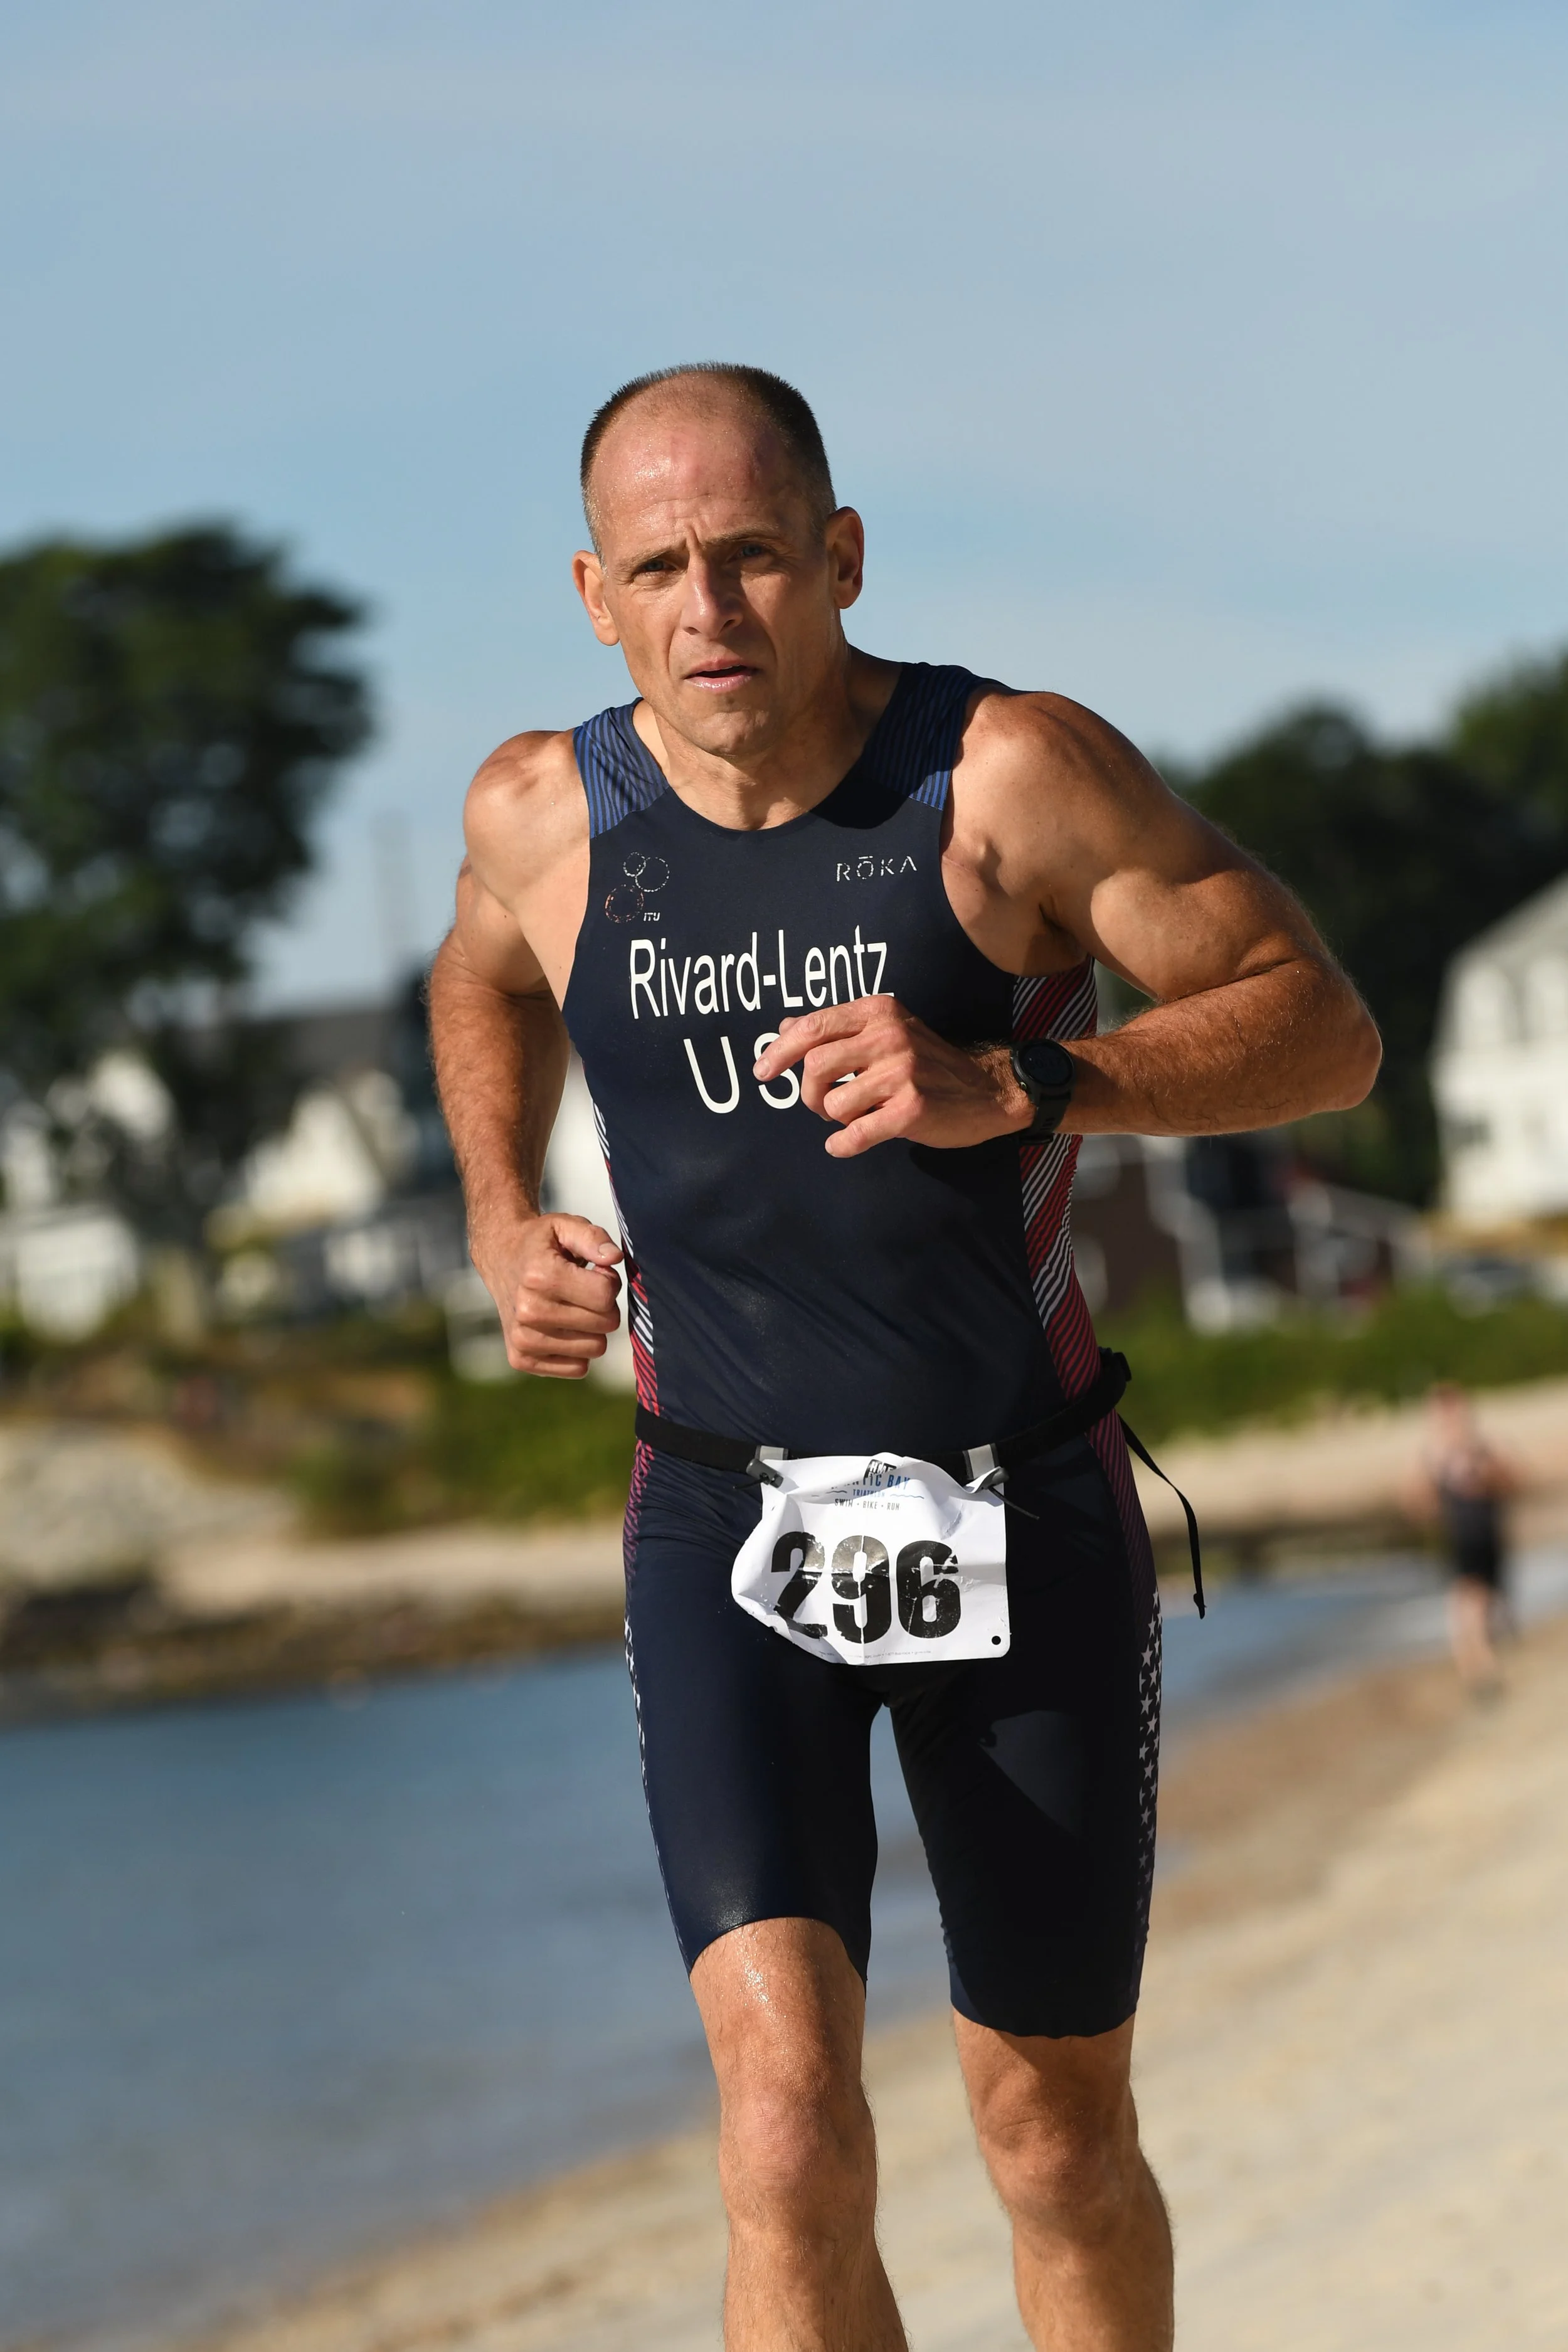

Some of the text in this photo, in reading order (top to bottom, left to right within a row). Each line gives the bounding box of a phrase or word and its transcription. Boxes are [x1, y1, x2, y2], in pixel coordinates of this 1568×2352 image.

[630, 925, 894, 1019] Rivard-Lentz
[684, 1032, 861, 1114] US
[862, 1500, 878, 1510] BIKE
[887, 1502, 900, 1511] RUN
[887, 1474, 911, 1490] BAY
[771, 1532, 961, 1644] 296
